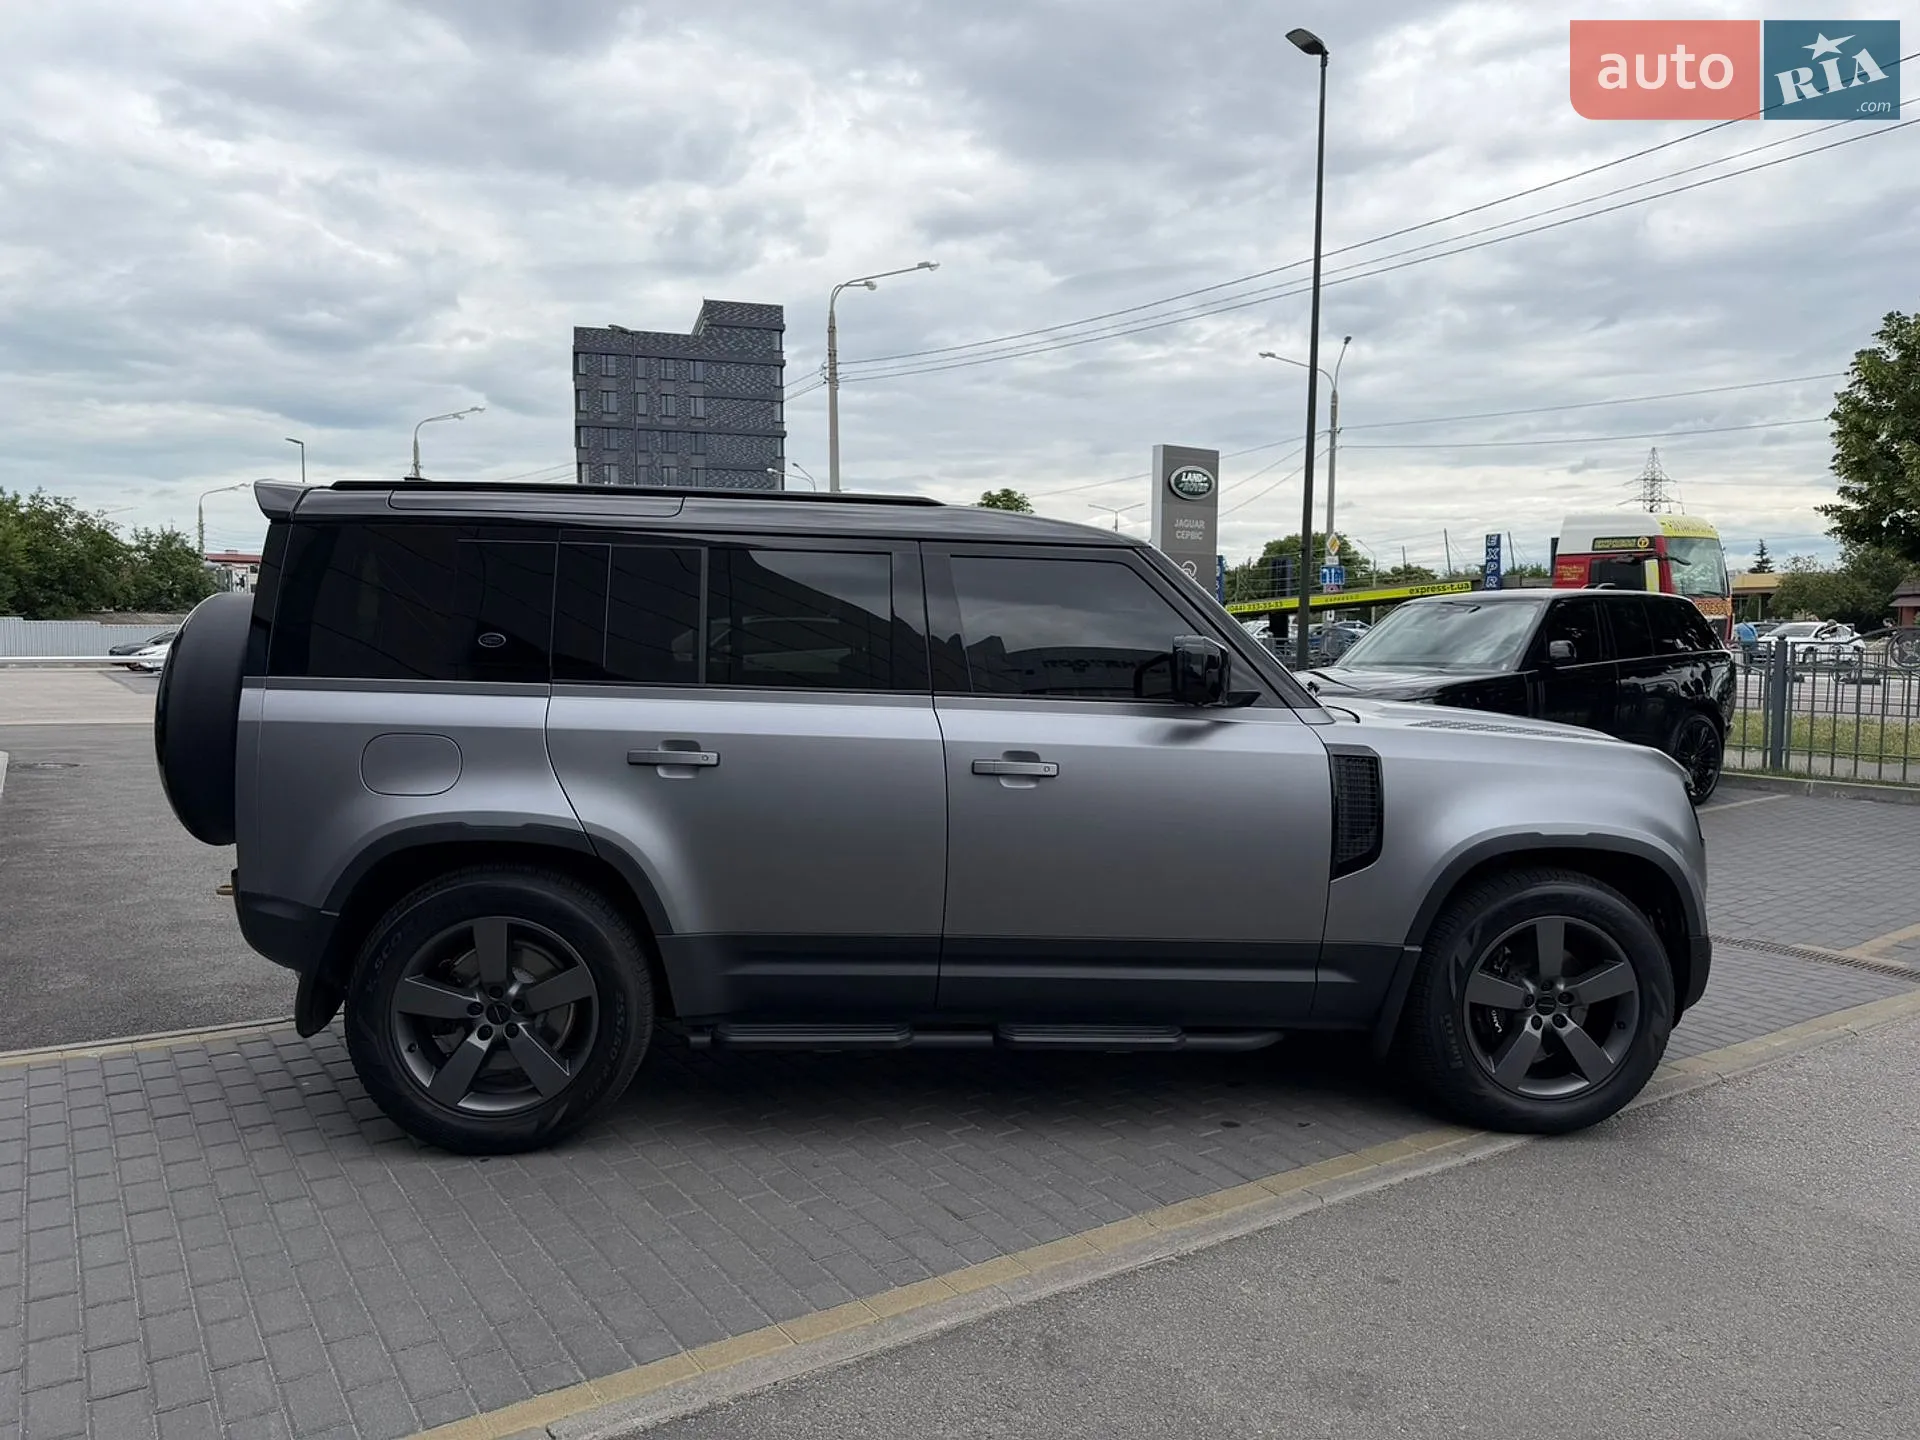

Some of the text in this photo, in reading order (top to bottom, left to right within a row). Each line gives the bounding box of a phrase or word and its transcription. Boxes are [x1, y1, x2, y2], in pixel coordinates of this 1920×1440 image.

[1181, 472, 1203, 482] LAND
[1174, 518, 1206, 529] JAGUAR
[1408, 581, 1471, 596] express-t.ua
